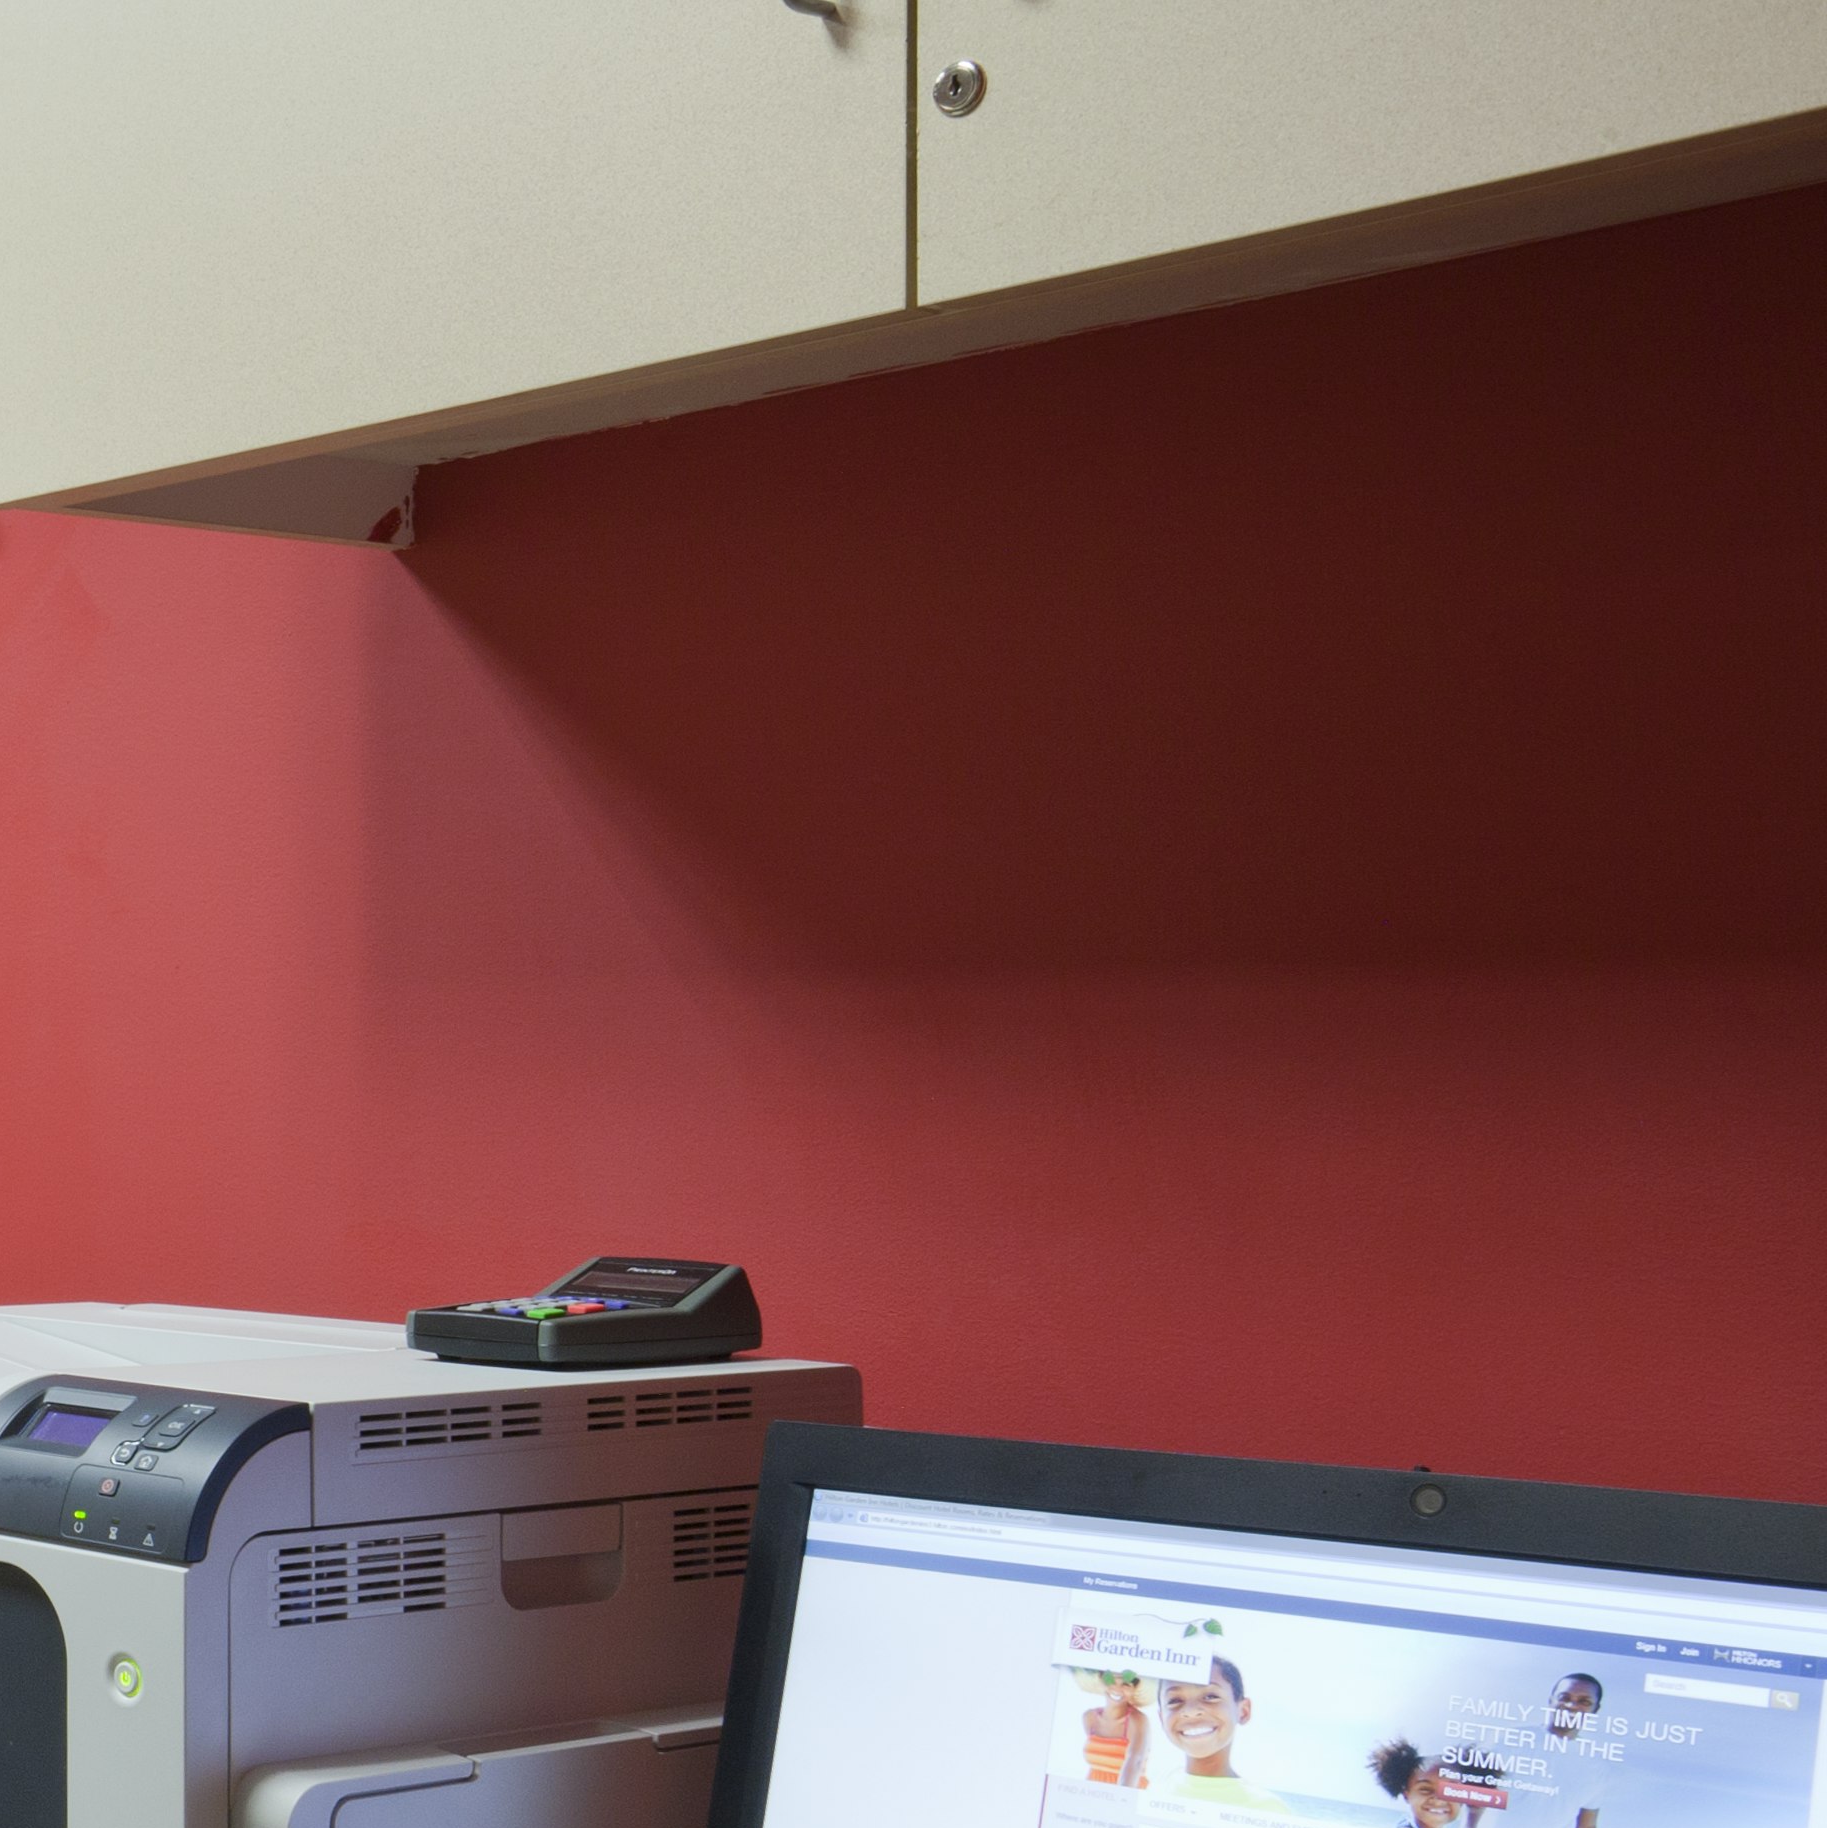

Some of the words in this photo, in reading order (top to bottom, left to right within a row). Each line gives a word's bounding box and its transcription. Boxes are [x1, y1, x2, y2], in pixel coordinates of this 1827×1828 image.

[1099, 1628, 1139, 1643] Hilton
[1097, 1639, 1162, 1662] Garden
[1165, 1648, 1197, 1667] Inn
[1636, 1641, 1656, 1654] Sign
[1680, 1647, 1700, 1658] Join
[1448, 1694, 1537, 1723] FAMILY
[1539, 1705, 1600, 1734] TIME
[1605, 1716, 1629, 1739] IS
[1635, 1721, 1705, 1747] JUST
[1445, 1719, 1537, 1750] BETTER
[1543, 1733, 1569, 1755] IN
[1576, 1737, 1626, 1764] THE
[1441, 1745, 1554, 1780] SUMMER.
[1439, 1767, 1462, 1782] Plan
[1463, 1771, 1485, 1786] your
[1149, 1799, 1186, 1815] OFFERS
